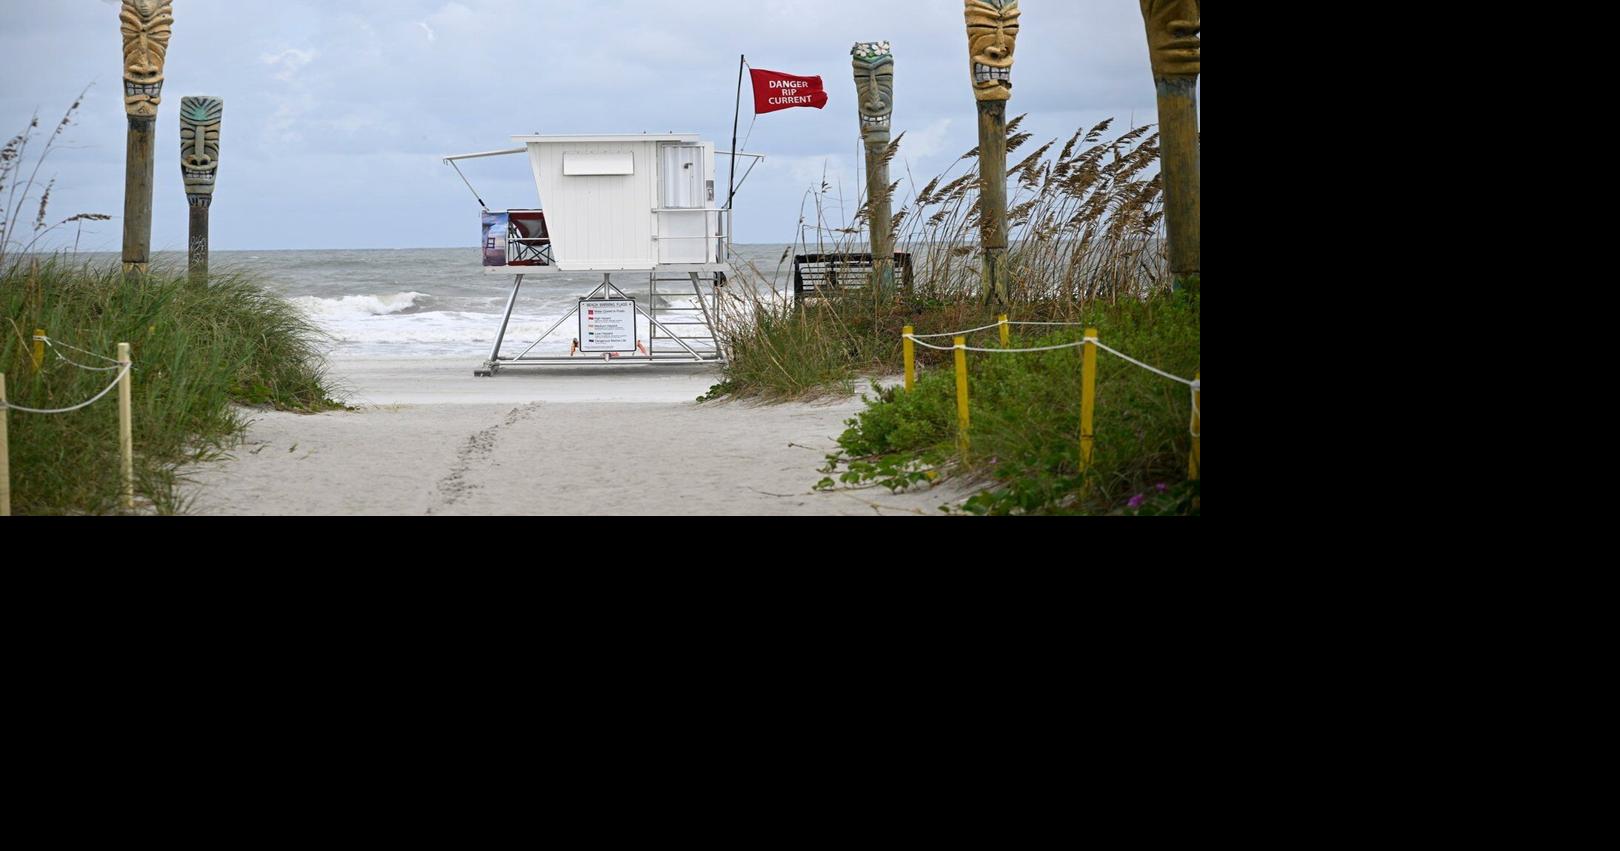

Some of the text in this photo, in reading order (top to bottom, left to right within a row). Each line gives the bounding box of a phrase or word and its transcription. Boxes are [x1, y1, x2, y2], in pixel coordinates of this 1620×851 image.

[768, 80, 809, 88] DANGER
[781, 88, 797, 96] RIP
[768, 95, 812, 104] CURRENT
